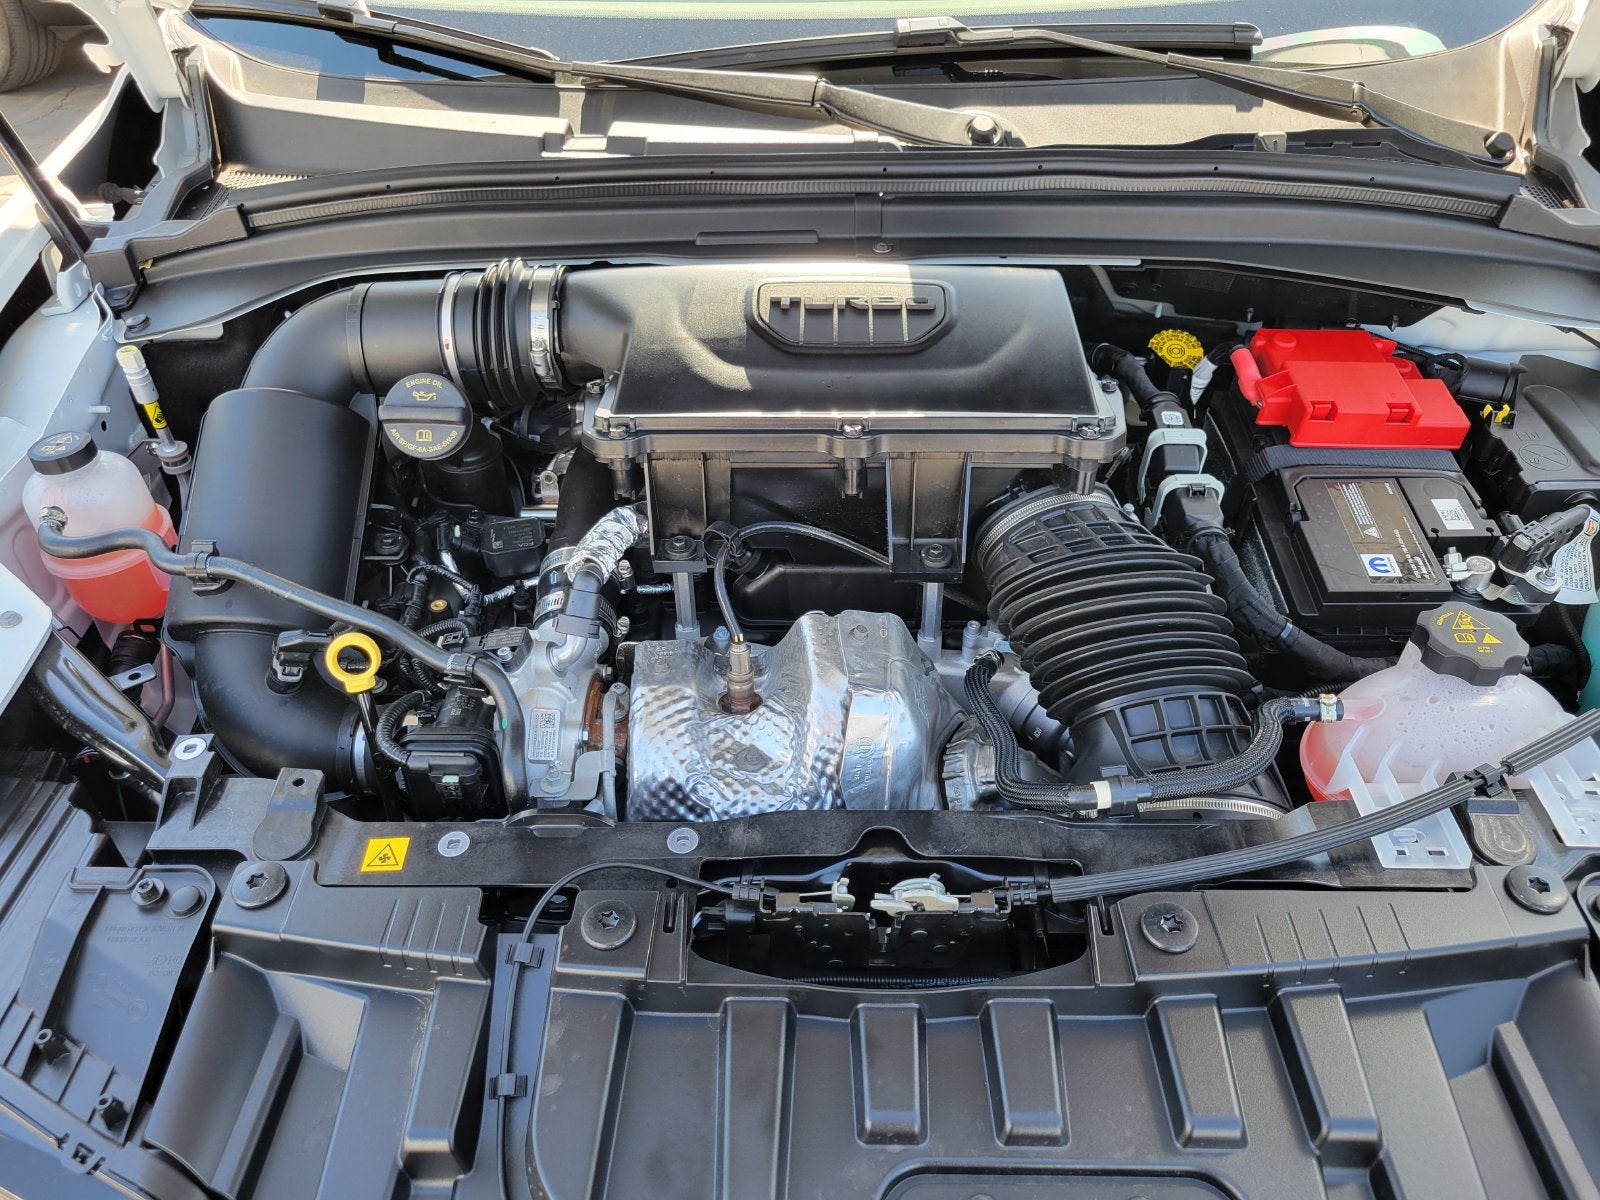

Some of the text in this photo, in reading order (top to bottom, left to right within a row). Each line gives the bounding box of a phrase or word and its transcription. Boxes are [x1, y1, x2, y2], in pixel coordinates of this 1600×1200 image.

[769, 295, 937, 310] TURBO
[405, 378, 443, 389] ENGINE OIL
